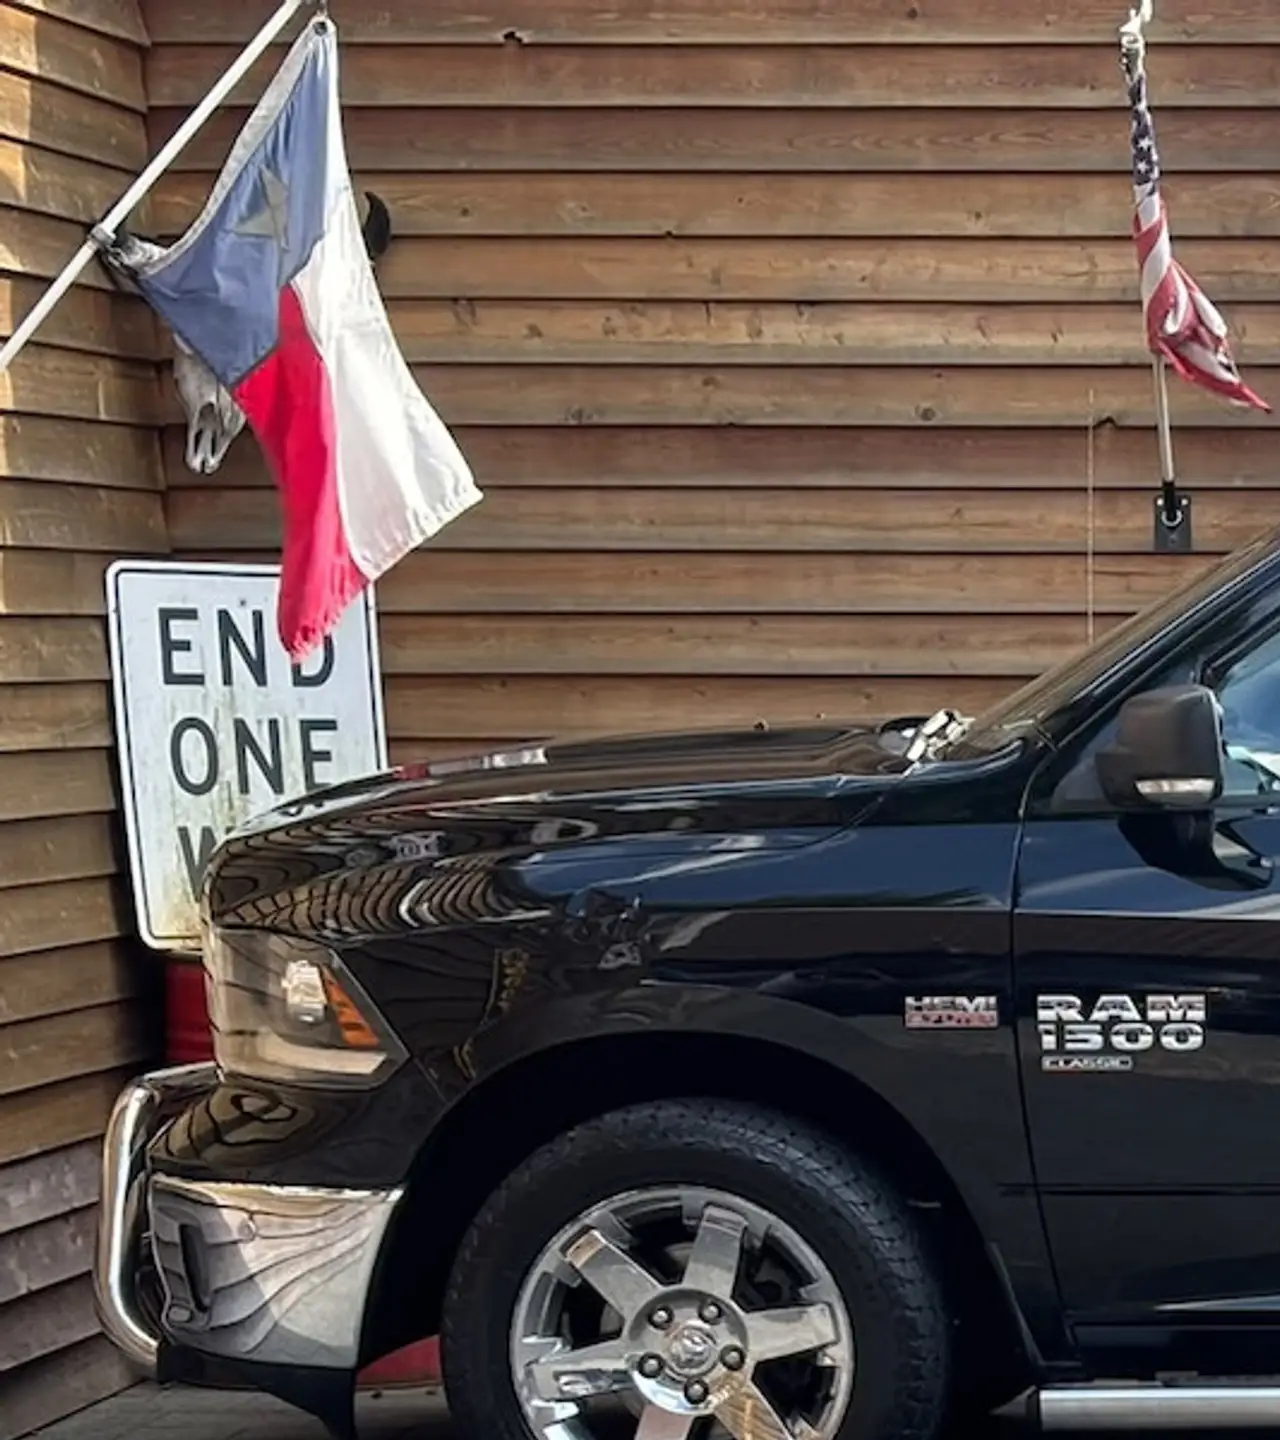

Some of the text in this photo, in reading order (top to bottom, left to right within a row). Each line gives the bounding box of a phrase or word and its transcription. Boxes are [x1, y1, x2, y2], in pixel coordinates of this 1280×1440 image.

[169, 716, 339, 797] ONE
[905, 995, 997, 1013] HEMI
[1037, 994, 1206, 1022] RAM
[1037, 1022, 1205, 1051] 1500
